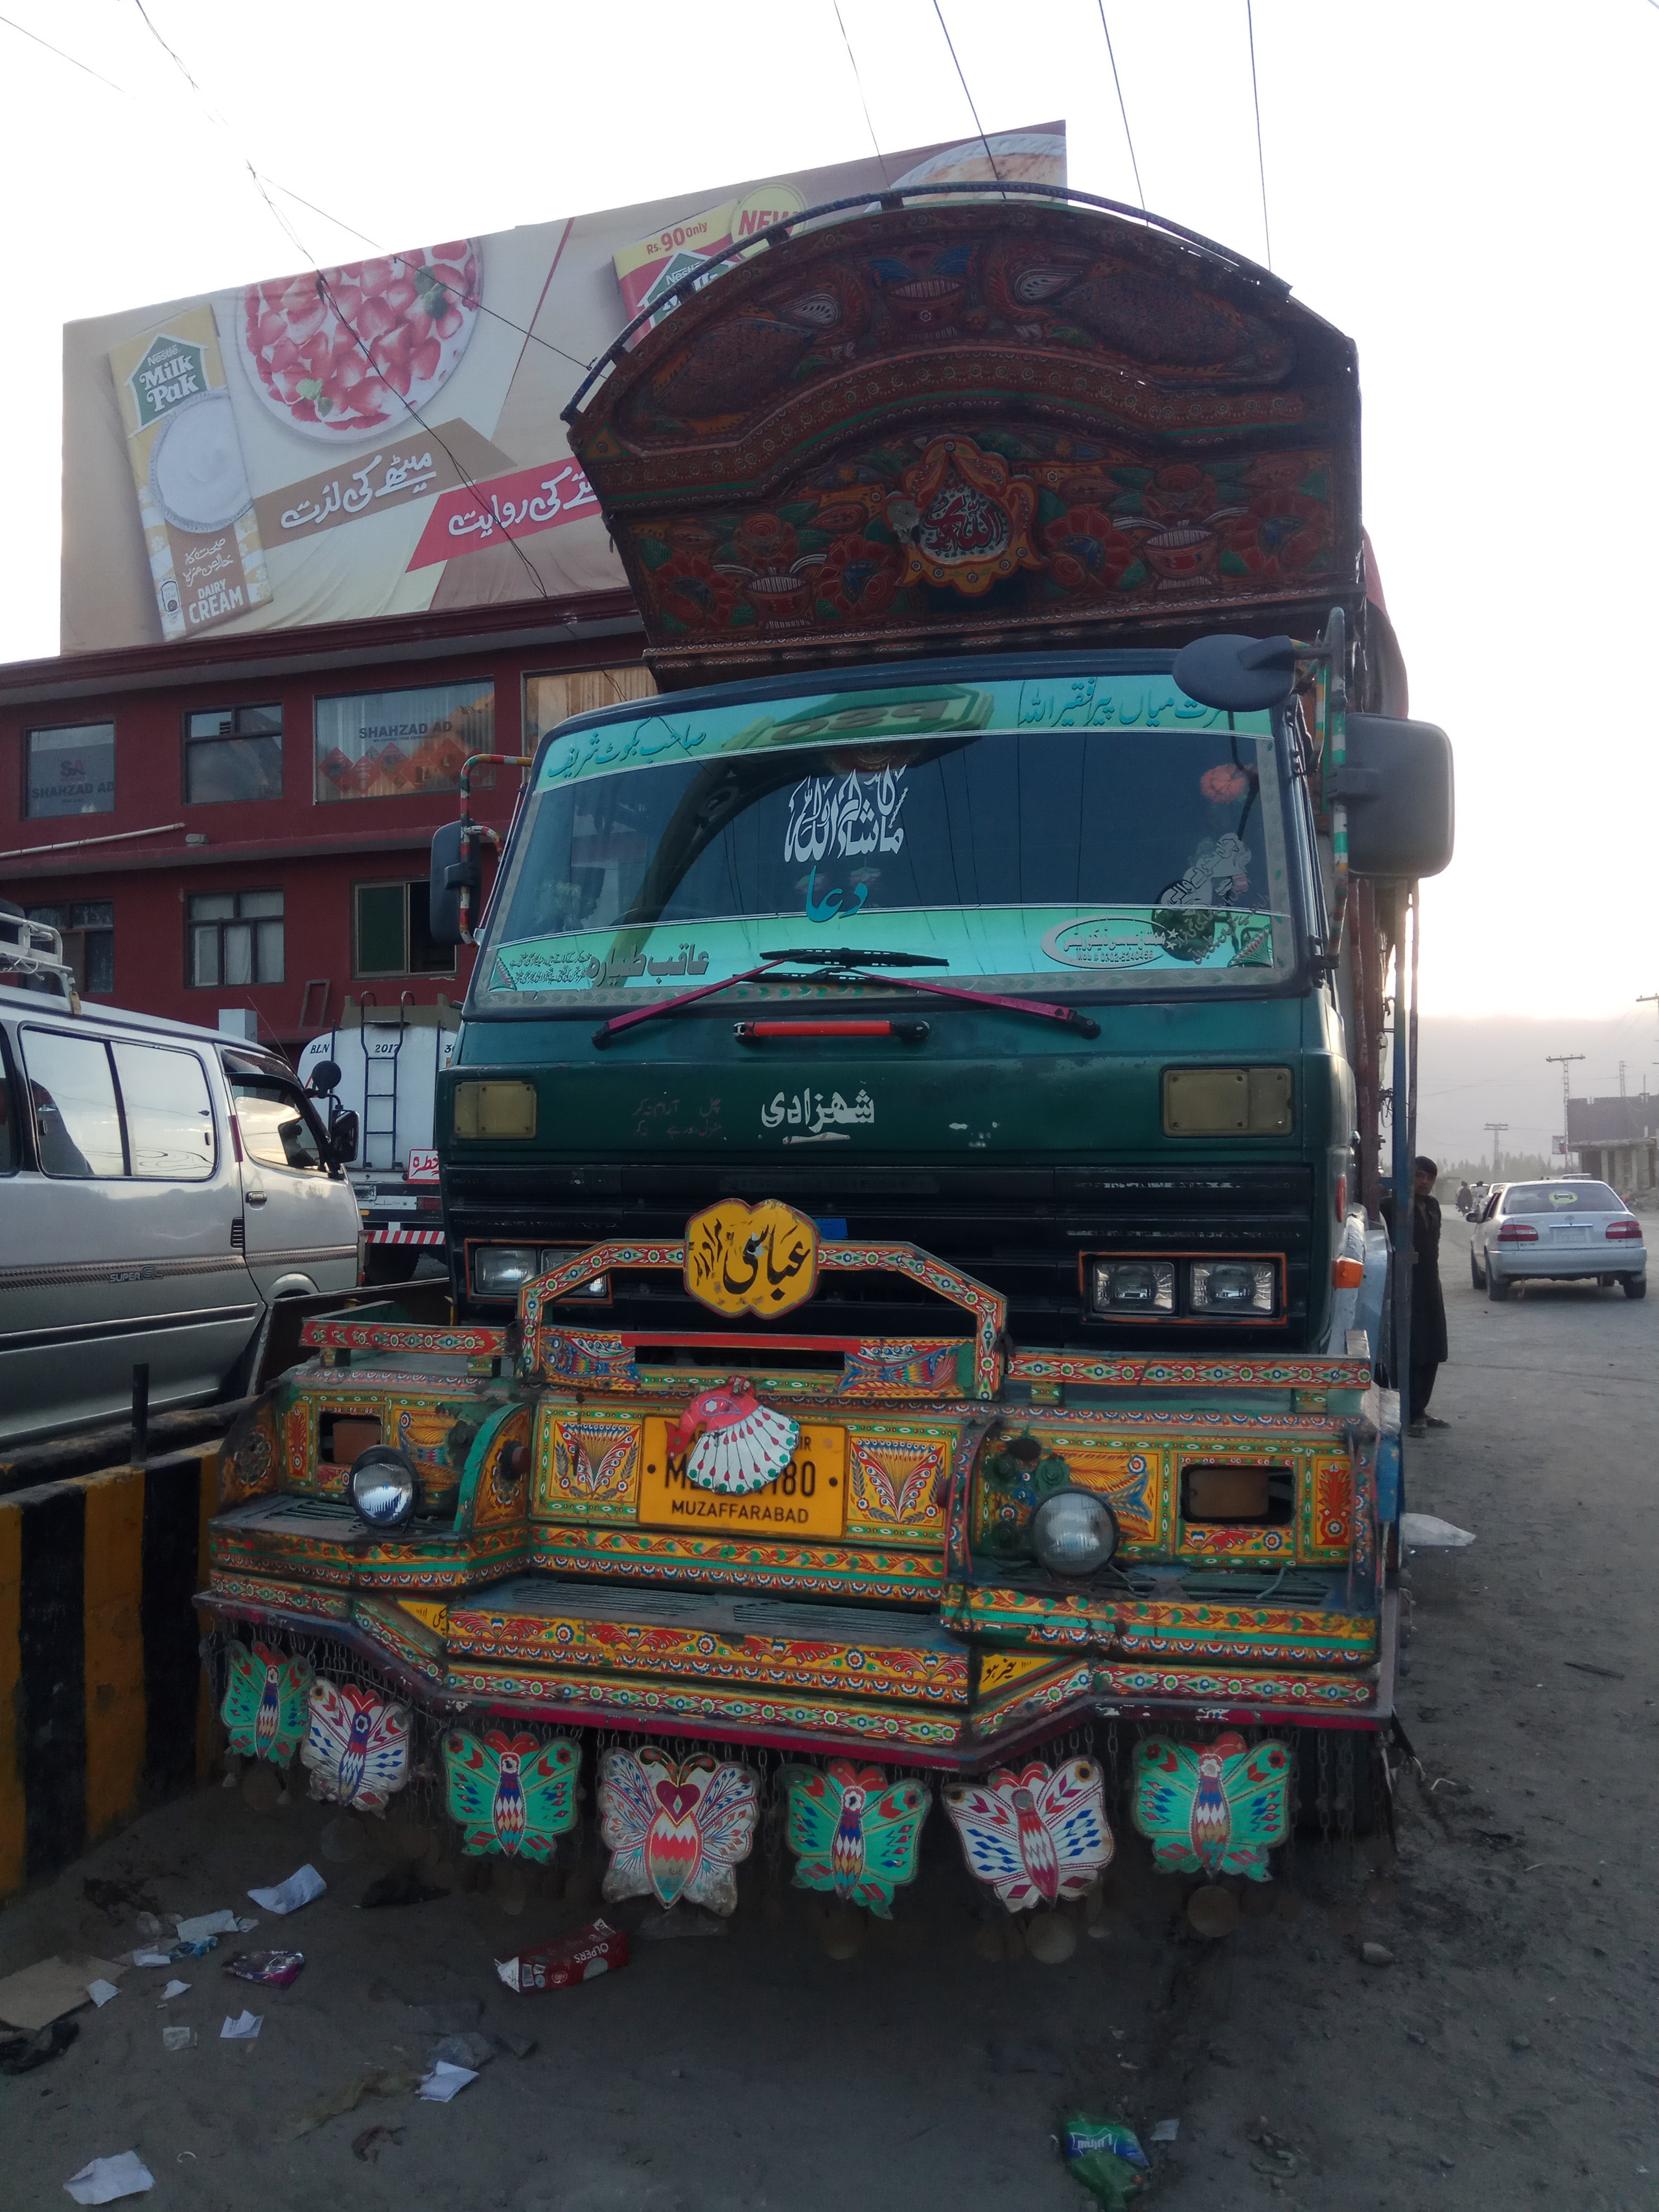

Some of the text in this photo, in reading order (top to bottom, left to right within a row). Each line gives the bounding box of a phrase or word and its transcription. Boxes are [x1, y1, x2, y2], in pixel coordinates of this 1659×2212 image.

[647, 222, 707, 255] Rs. 90 Only
[139, 355, 194, 390] Milk
[146, 373, 200, 412] Pak
[343, 455, 383, 513] کی
[529, 465, 573, 522] کی
[448, 494, 529, 539] روایت
[189, 585, 244, 623] CREAM
[198, 578, 226, 600] DAIRY
[359, 723, 428, 739] SHAHZAD
[432, 720, 453, 732] AD
[32, 783, 93, 799] SHAHZAD
[806, 865, 868, 923] دعا
[647, 942, 710, 985] عاقب
[310, 1043, 331, 1054] BLN
[375, 1043, 400, 1054] 2017
[761, 1088, 875, 1134] شہزادی
[110, 1264, 163, 1283] SUPER GL
[723, 1224, 811, 1301] عباسی
[671, 1499, 809, 1524] MUZAFFARABAD
